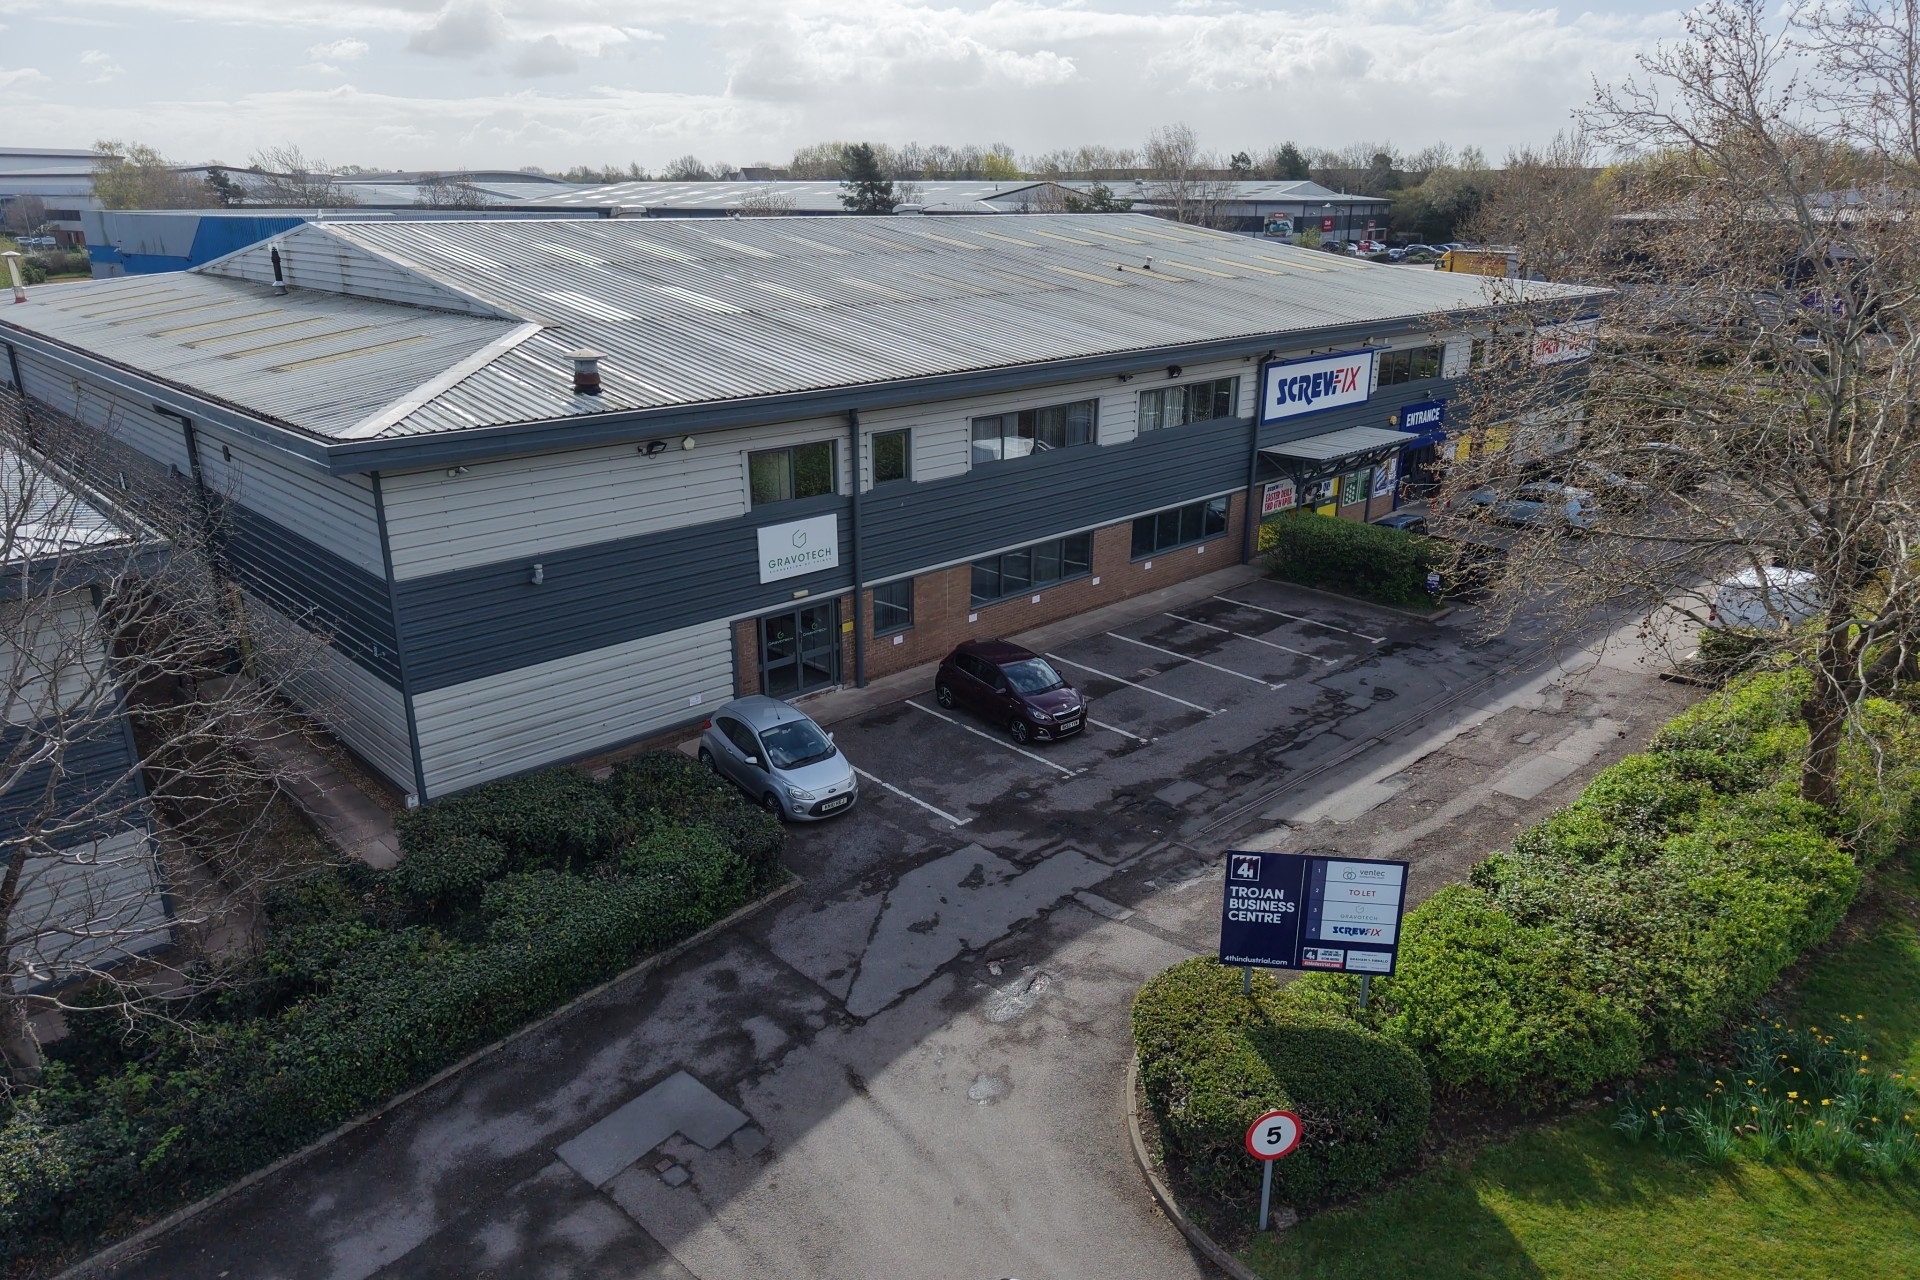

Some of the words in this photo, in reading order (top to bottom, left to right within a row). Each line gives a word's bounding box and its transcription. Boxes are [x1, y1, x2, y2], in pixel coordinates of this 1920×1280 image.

[1277, 366, 1361, 405] SCREWFIX
[1406, 408, 1440, 427] ENTRANCE
[1265, 491, 1280, 502] EASTER
[1281, 487, 1293, 499] DEALS
[768, 547, 832, 569] GRAVOTECH
[1360, 869, 1386, 877] ventec
[1229, 886, 1284, 900] TROJAN
[1229, 898, 1295, 912] BUSINESS
[1228, 910, 1282, 924] CENTRE
[1332, 926, 1382, 937] SCREWFIX
[1224, 955, 1288, 966] 4thindustrial.com
[1266, 1126, 1282, 1145] 5
